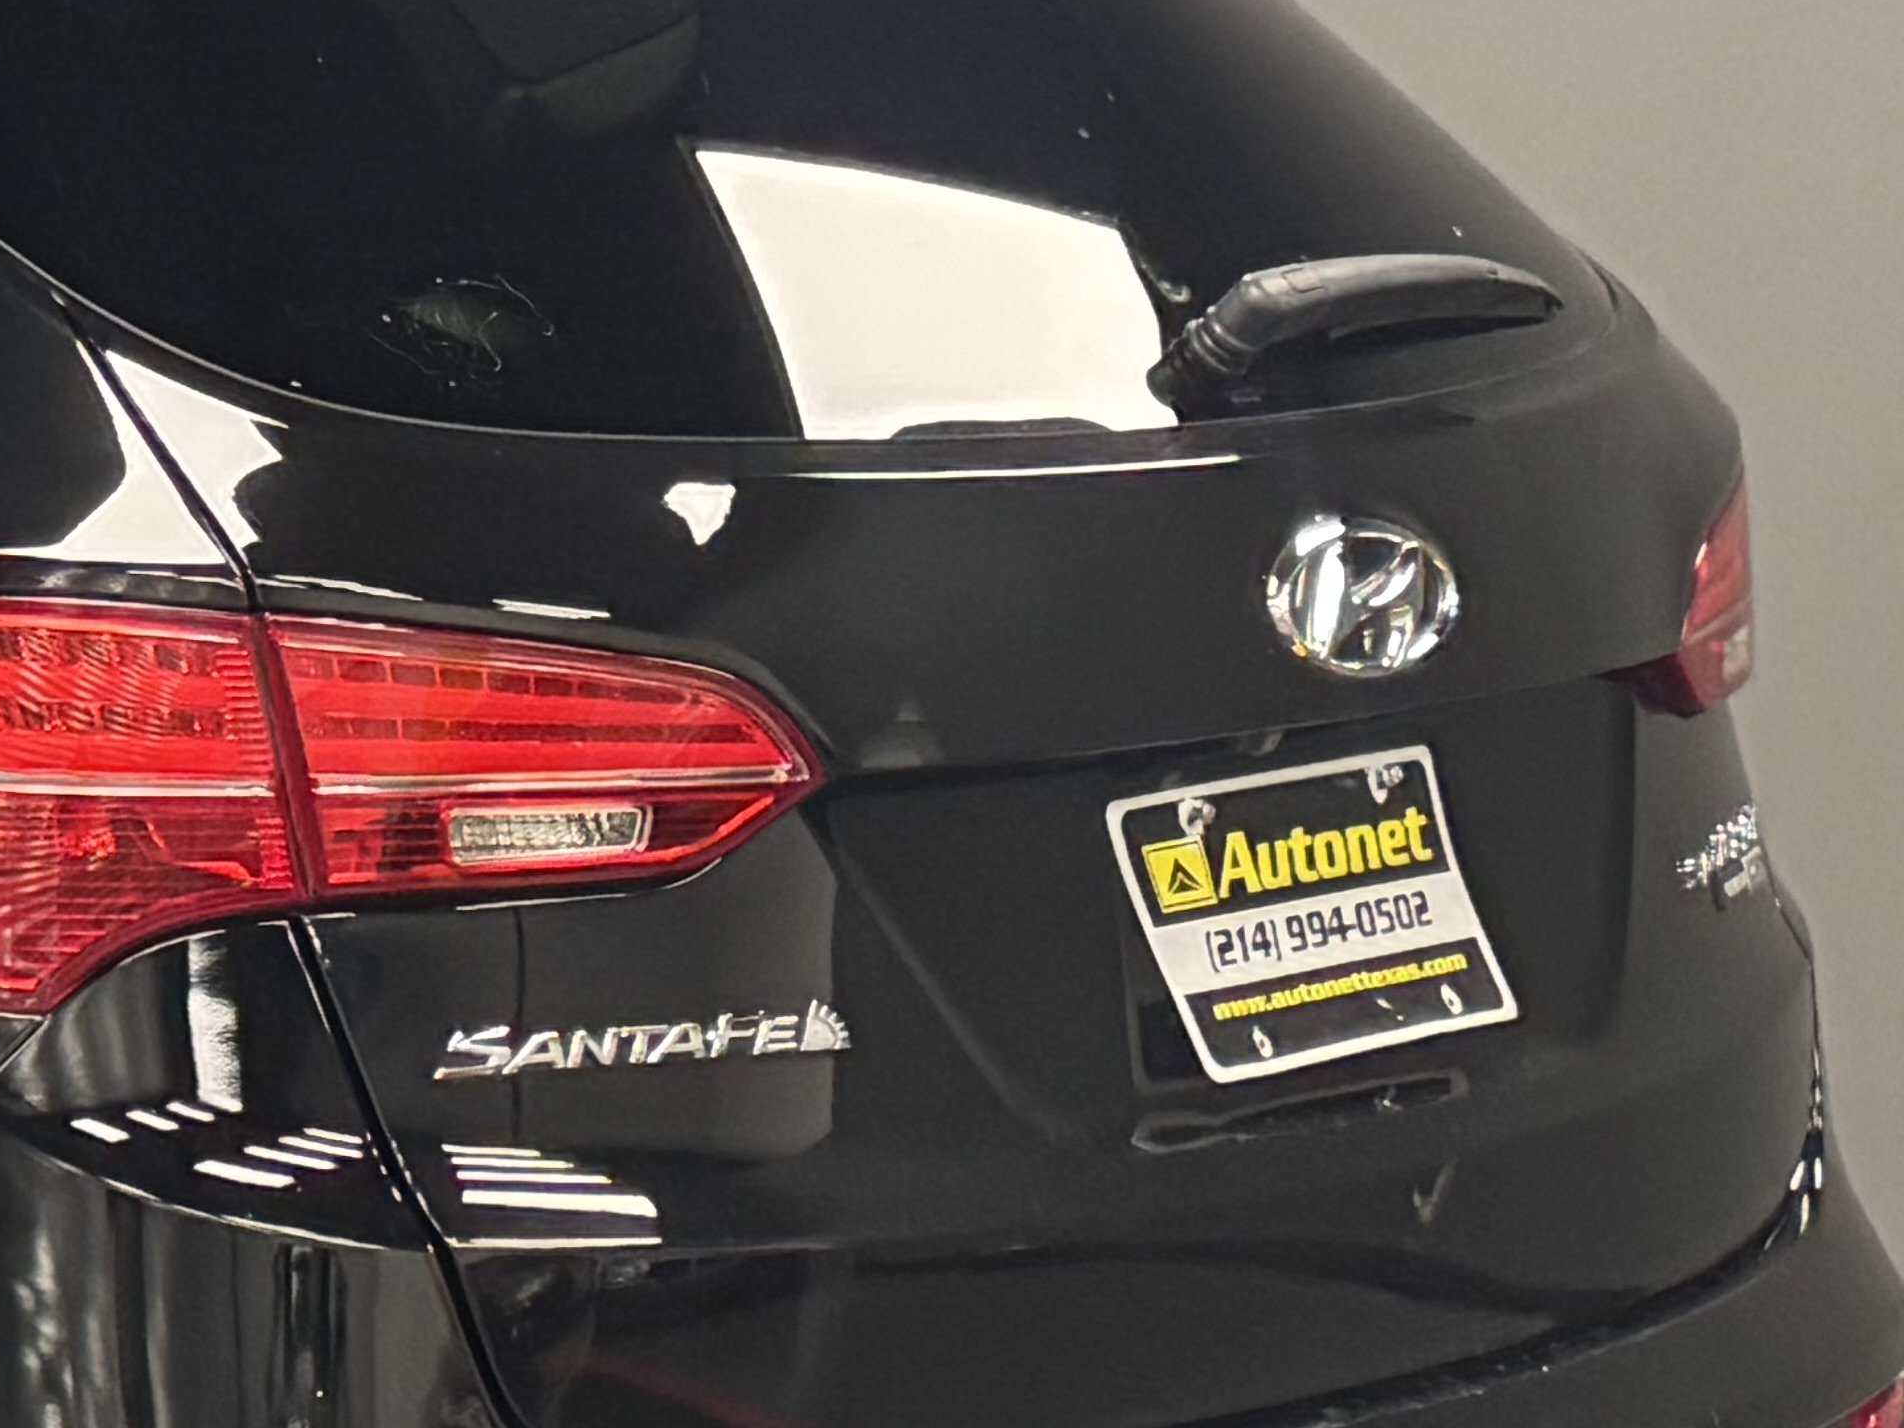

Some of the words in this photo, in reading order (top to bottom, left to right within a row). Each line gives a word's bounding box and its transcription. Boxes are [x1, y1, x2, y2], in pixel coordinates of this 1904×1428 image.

[1219, 806, 1433, 899] Autonet
[1205, 919, 1282, 973] (214)
[1286, 890, 1433, 952] 994-0502
[1212, 952, 1469, 1021] www.autonettexas.com
